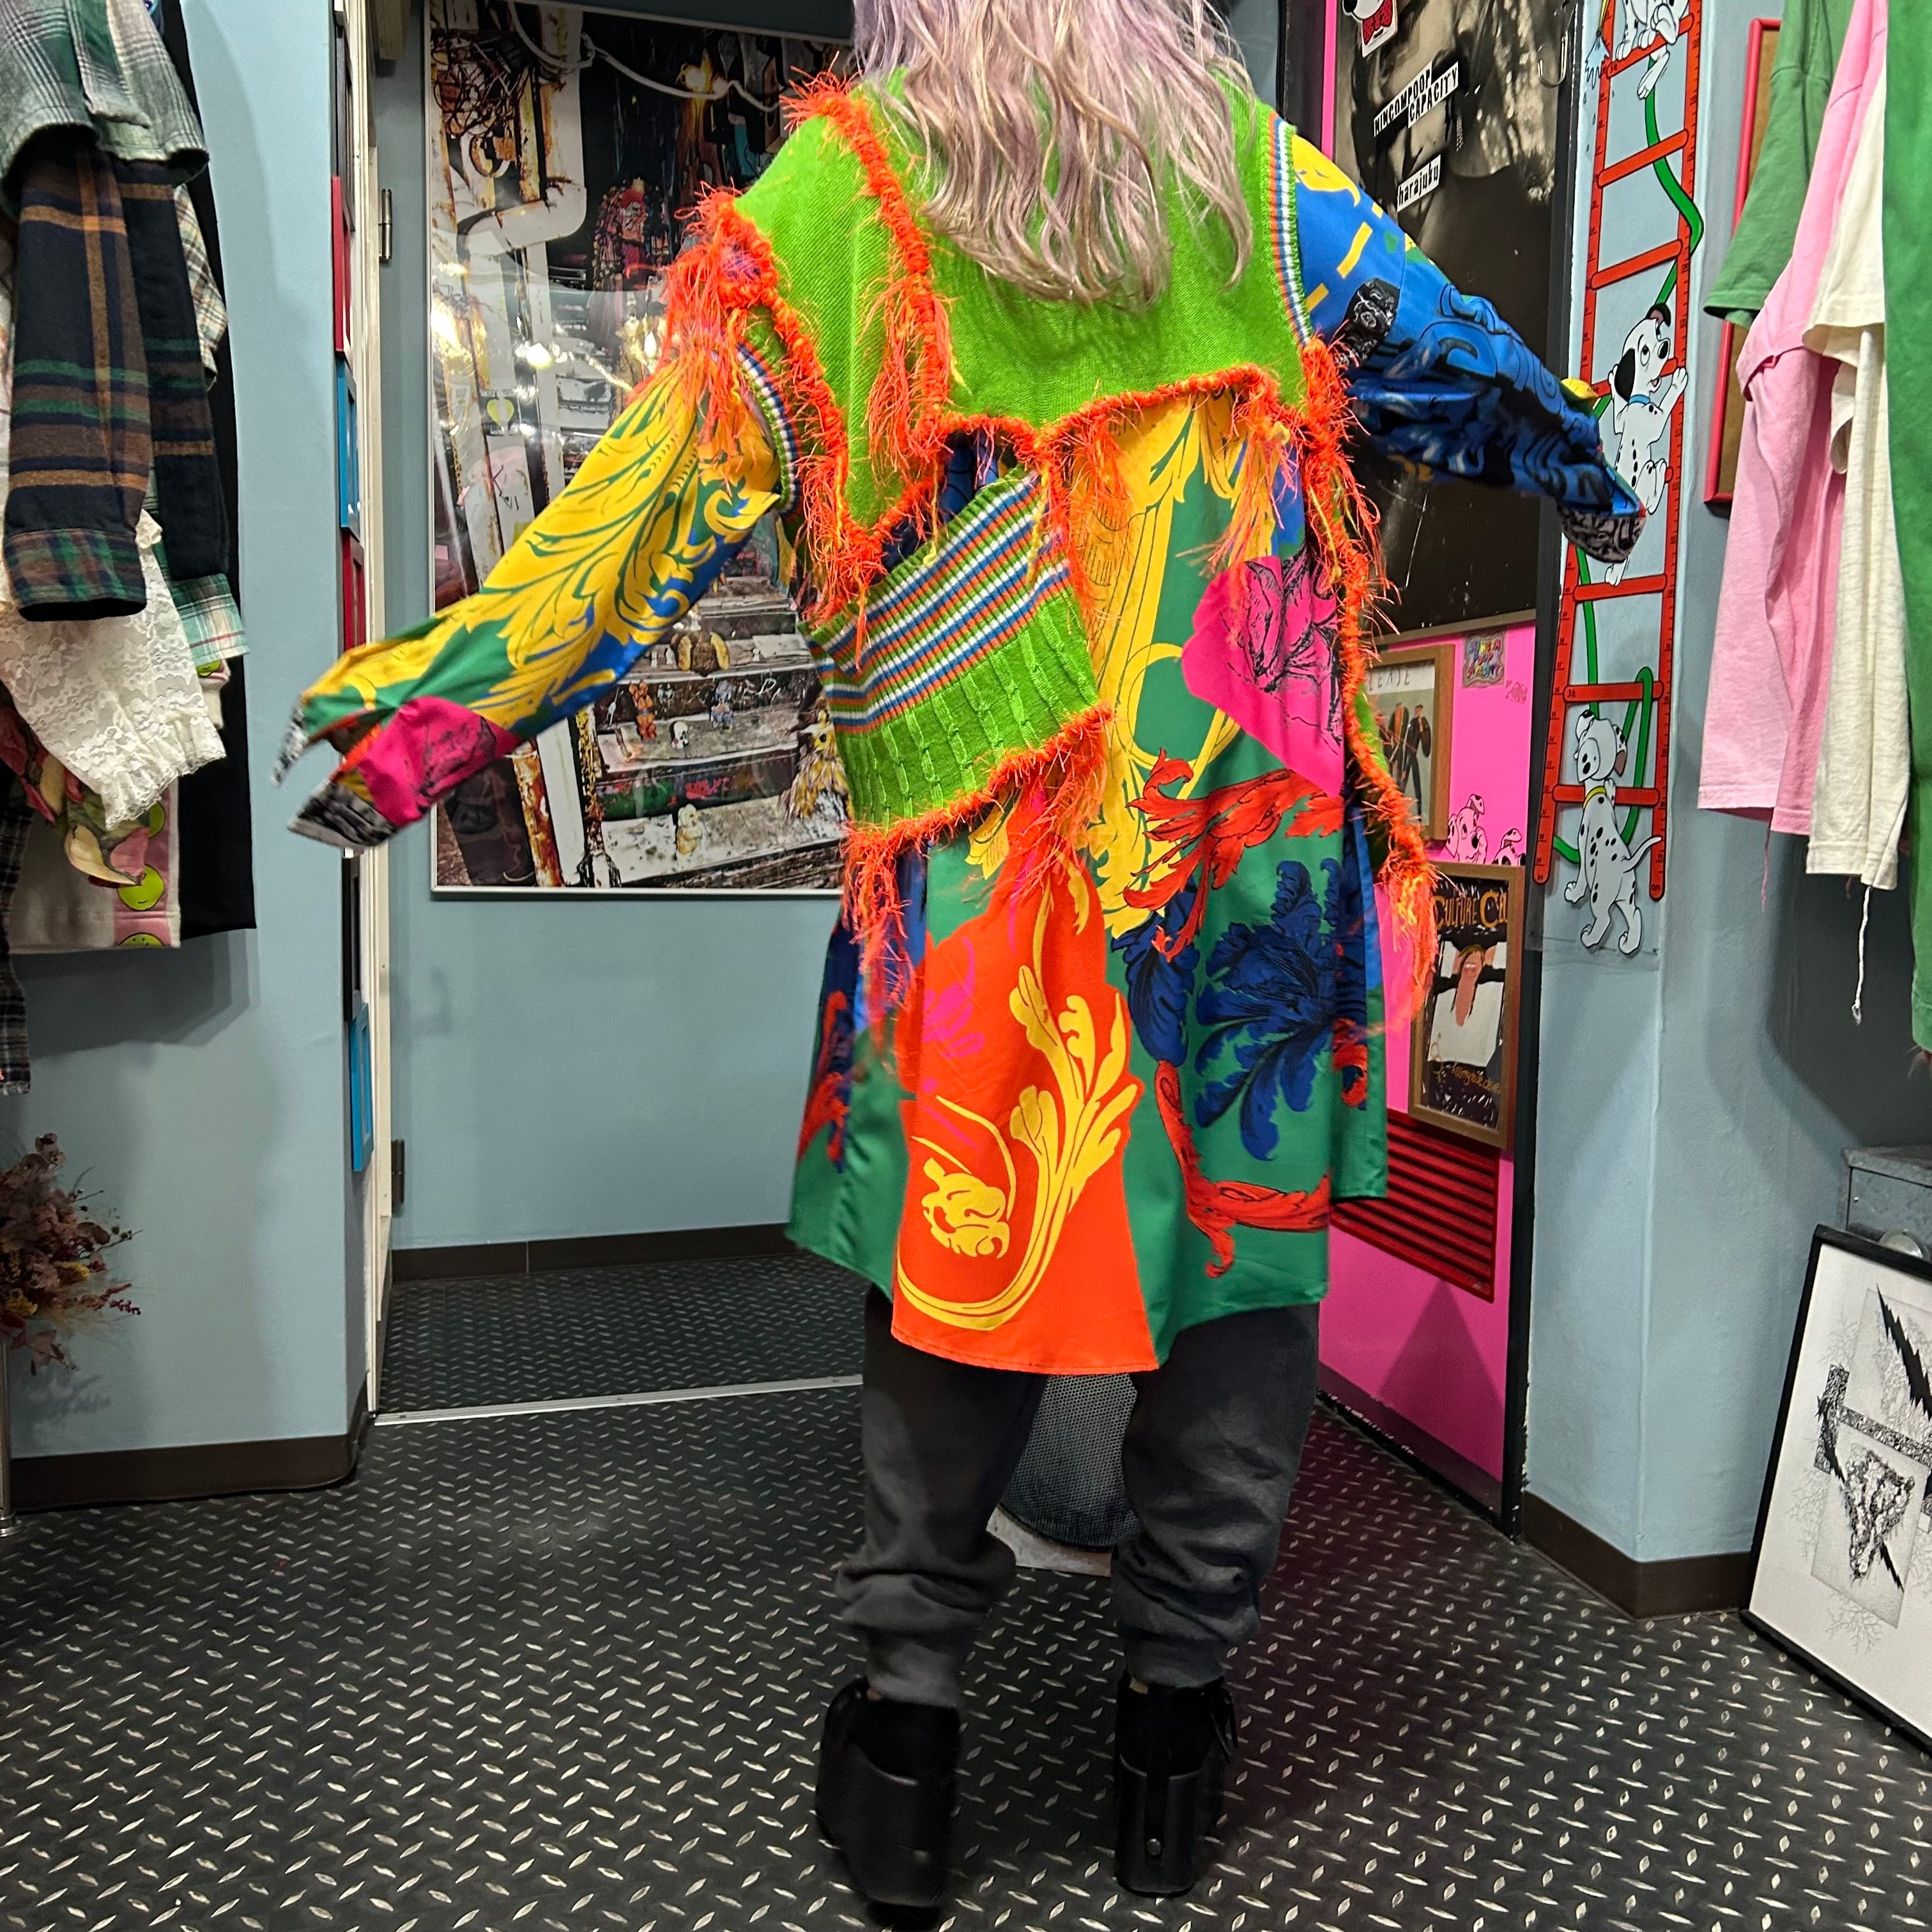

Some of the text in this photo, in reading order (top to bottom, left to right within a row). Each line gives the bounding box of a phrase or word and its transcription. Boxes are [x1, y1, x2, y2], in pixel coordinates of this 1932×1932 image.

[1374, 68, 1431, 136] NINCOMPOOP
[1409, 66, 1457, 123] CAPACITY
[1399, 162, 1439, 206] harajuku
[1434, 896, 1477, 931] CULTURE
